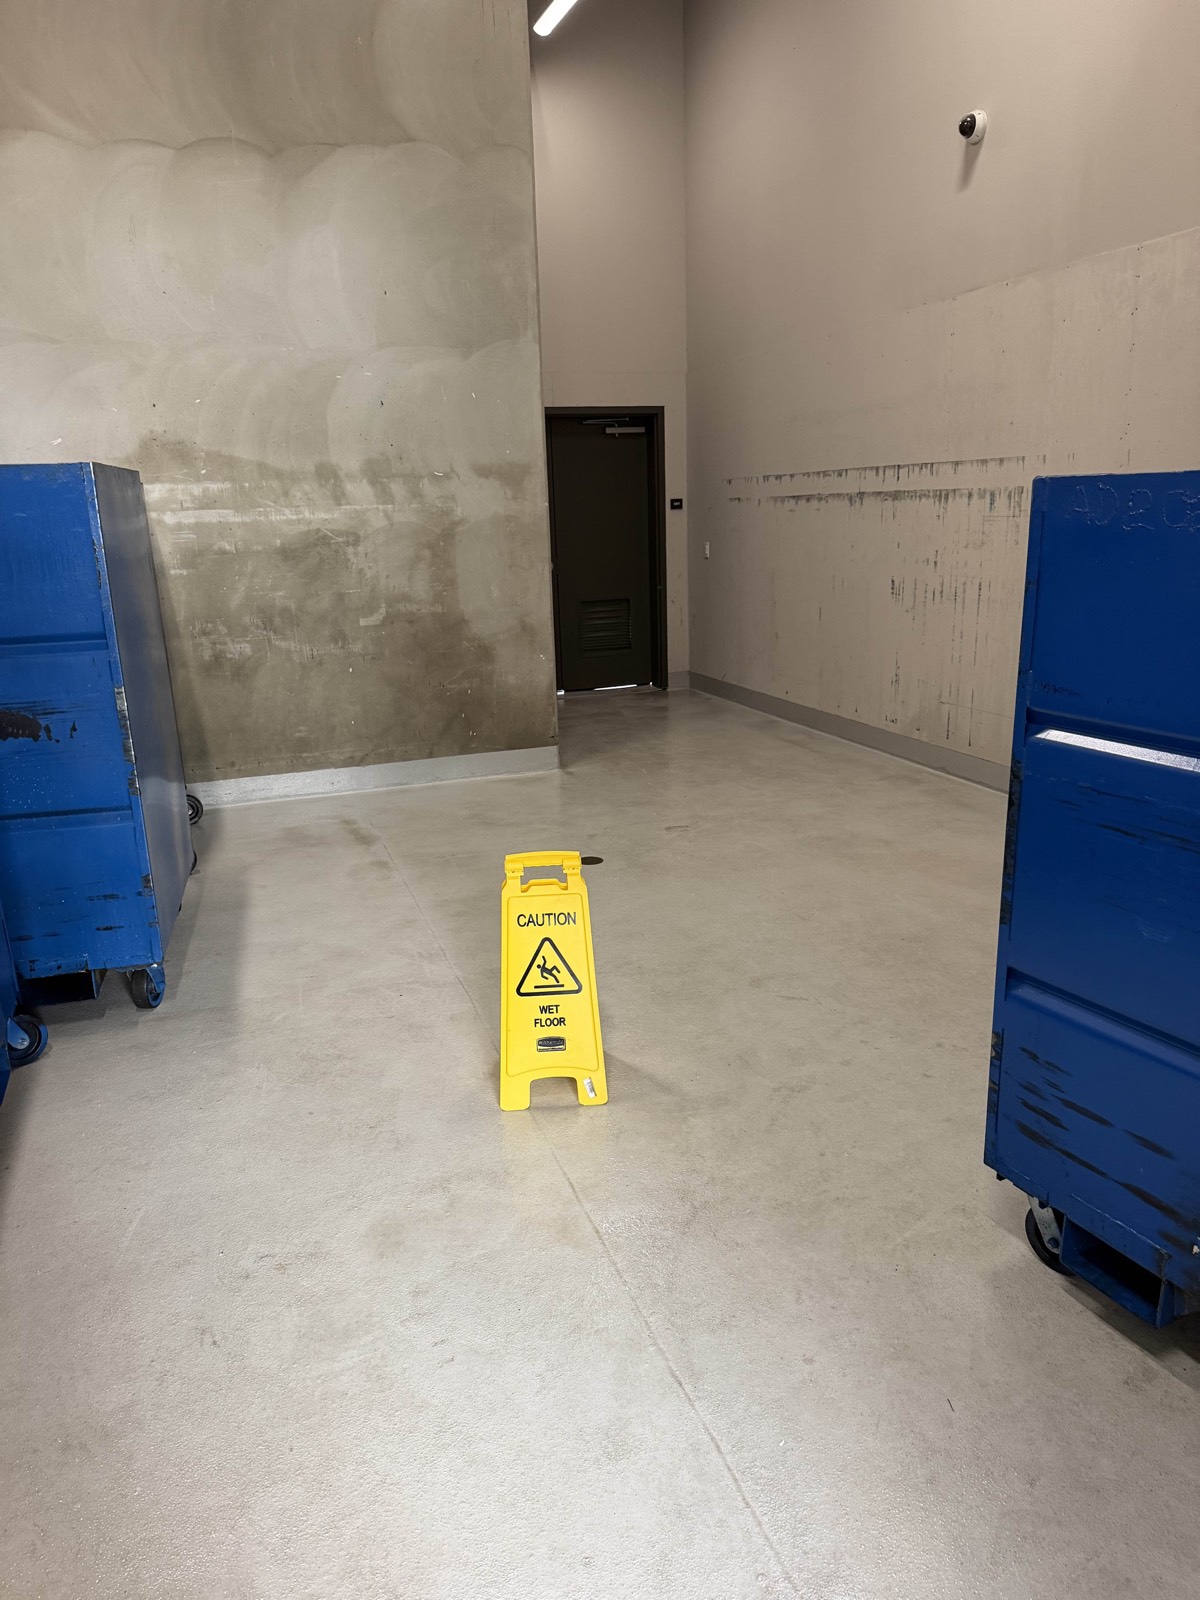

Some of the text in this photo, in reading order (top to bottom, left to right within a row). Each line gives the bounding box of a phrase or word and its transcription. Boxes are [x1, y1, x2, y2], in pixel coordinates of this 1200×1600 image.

[517, 912, 577, 928] CAUTION
[538, 1004, 560, 1015] WET
[534, 1017, 566, 1028] FLOOR
